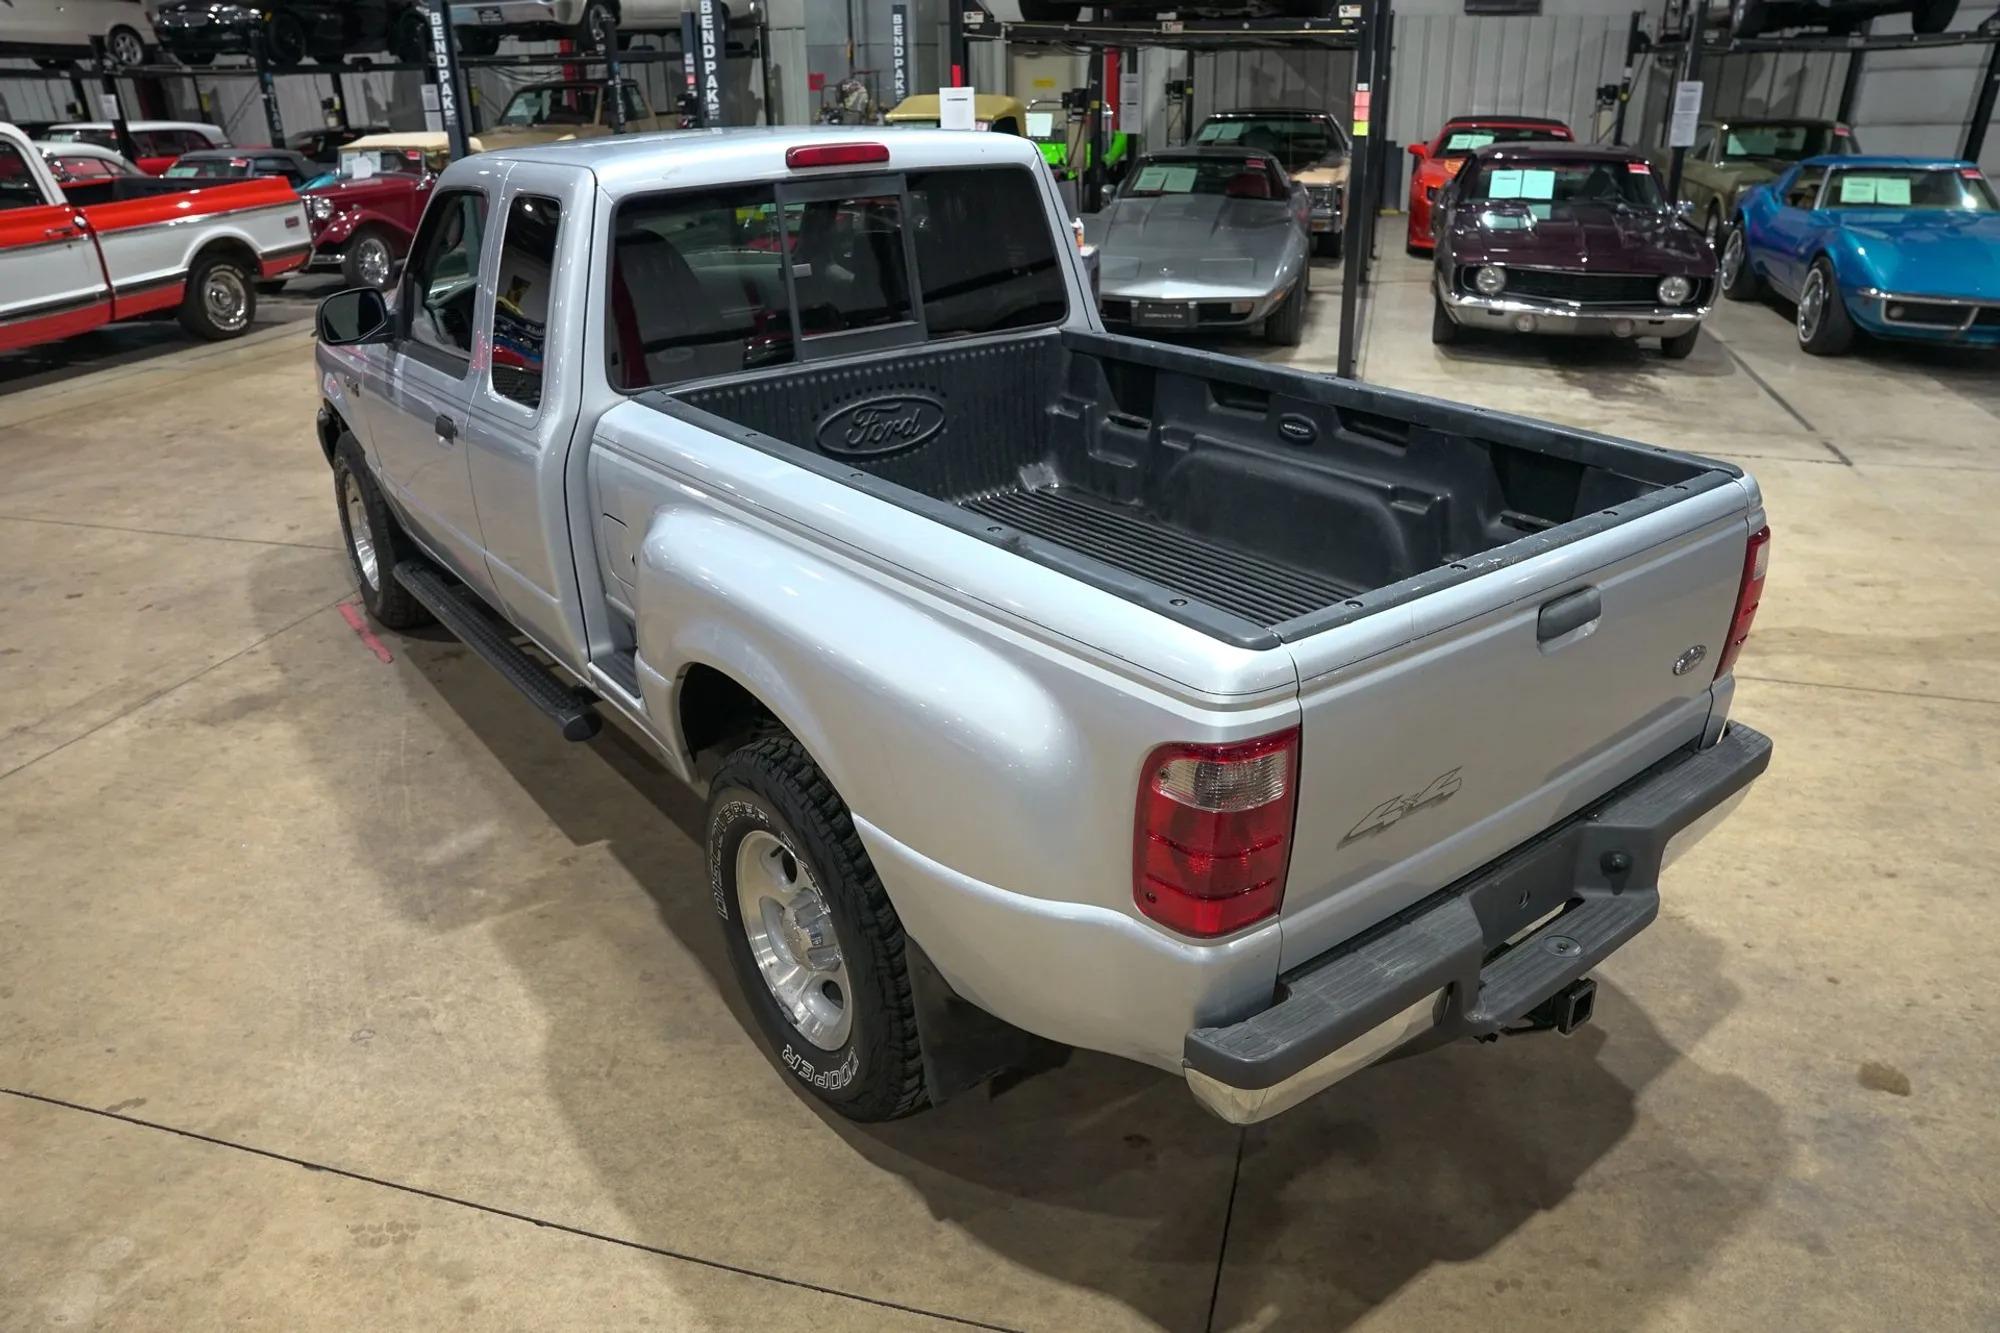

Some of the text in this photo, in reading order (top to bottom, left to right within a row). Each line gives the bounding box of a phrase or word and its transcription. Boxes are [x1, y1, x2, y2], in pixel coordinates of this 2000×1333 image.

[431, 12, 455, 109] BENDPAK
[701, 0, 719, 102] BENDPAK
[893, 14, 904, 89] BENDPAK
[846, 402, 920, 444] Ford
[1337, 766, 1462, 850] 4x4
[782, 1044, 859, 1090] COOPER
